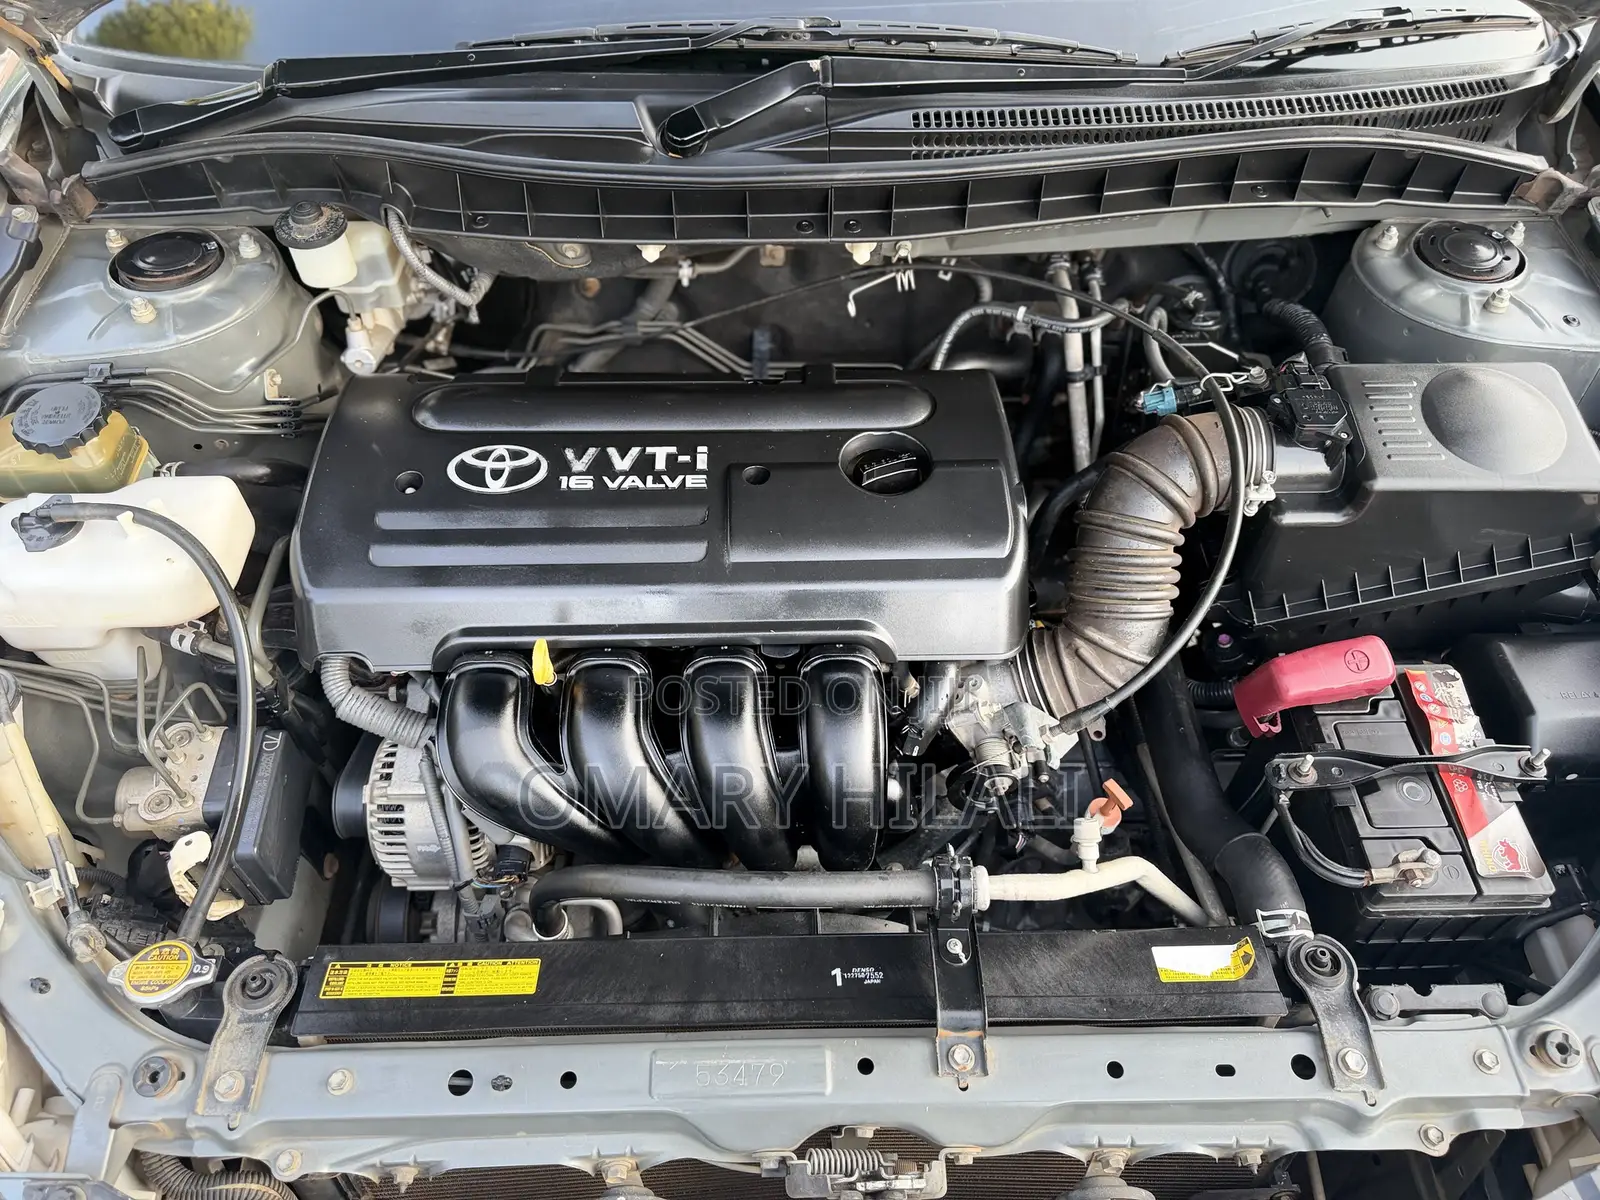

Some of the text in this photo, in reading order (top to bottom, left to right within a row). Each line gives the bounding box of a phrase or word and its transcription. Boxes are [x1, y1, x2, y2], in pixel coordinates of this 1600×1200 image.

[559, 474, 709, 491] 16 VALVE
[193, 965, 210, 973] 0.9
